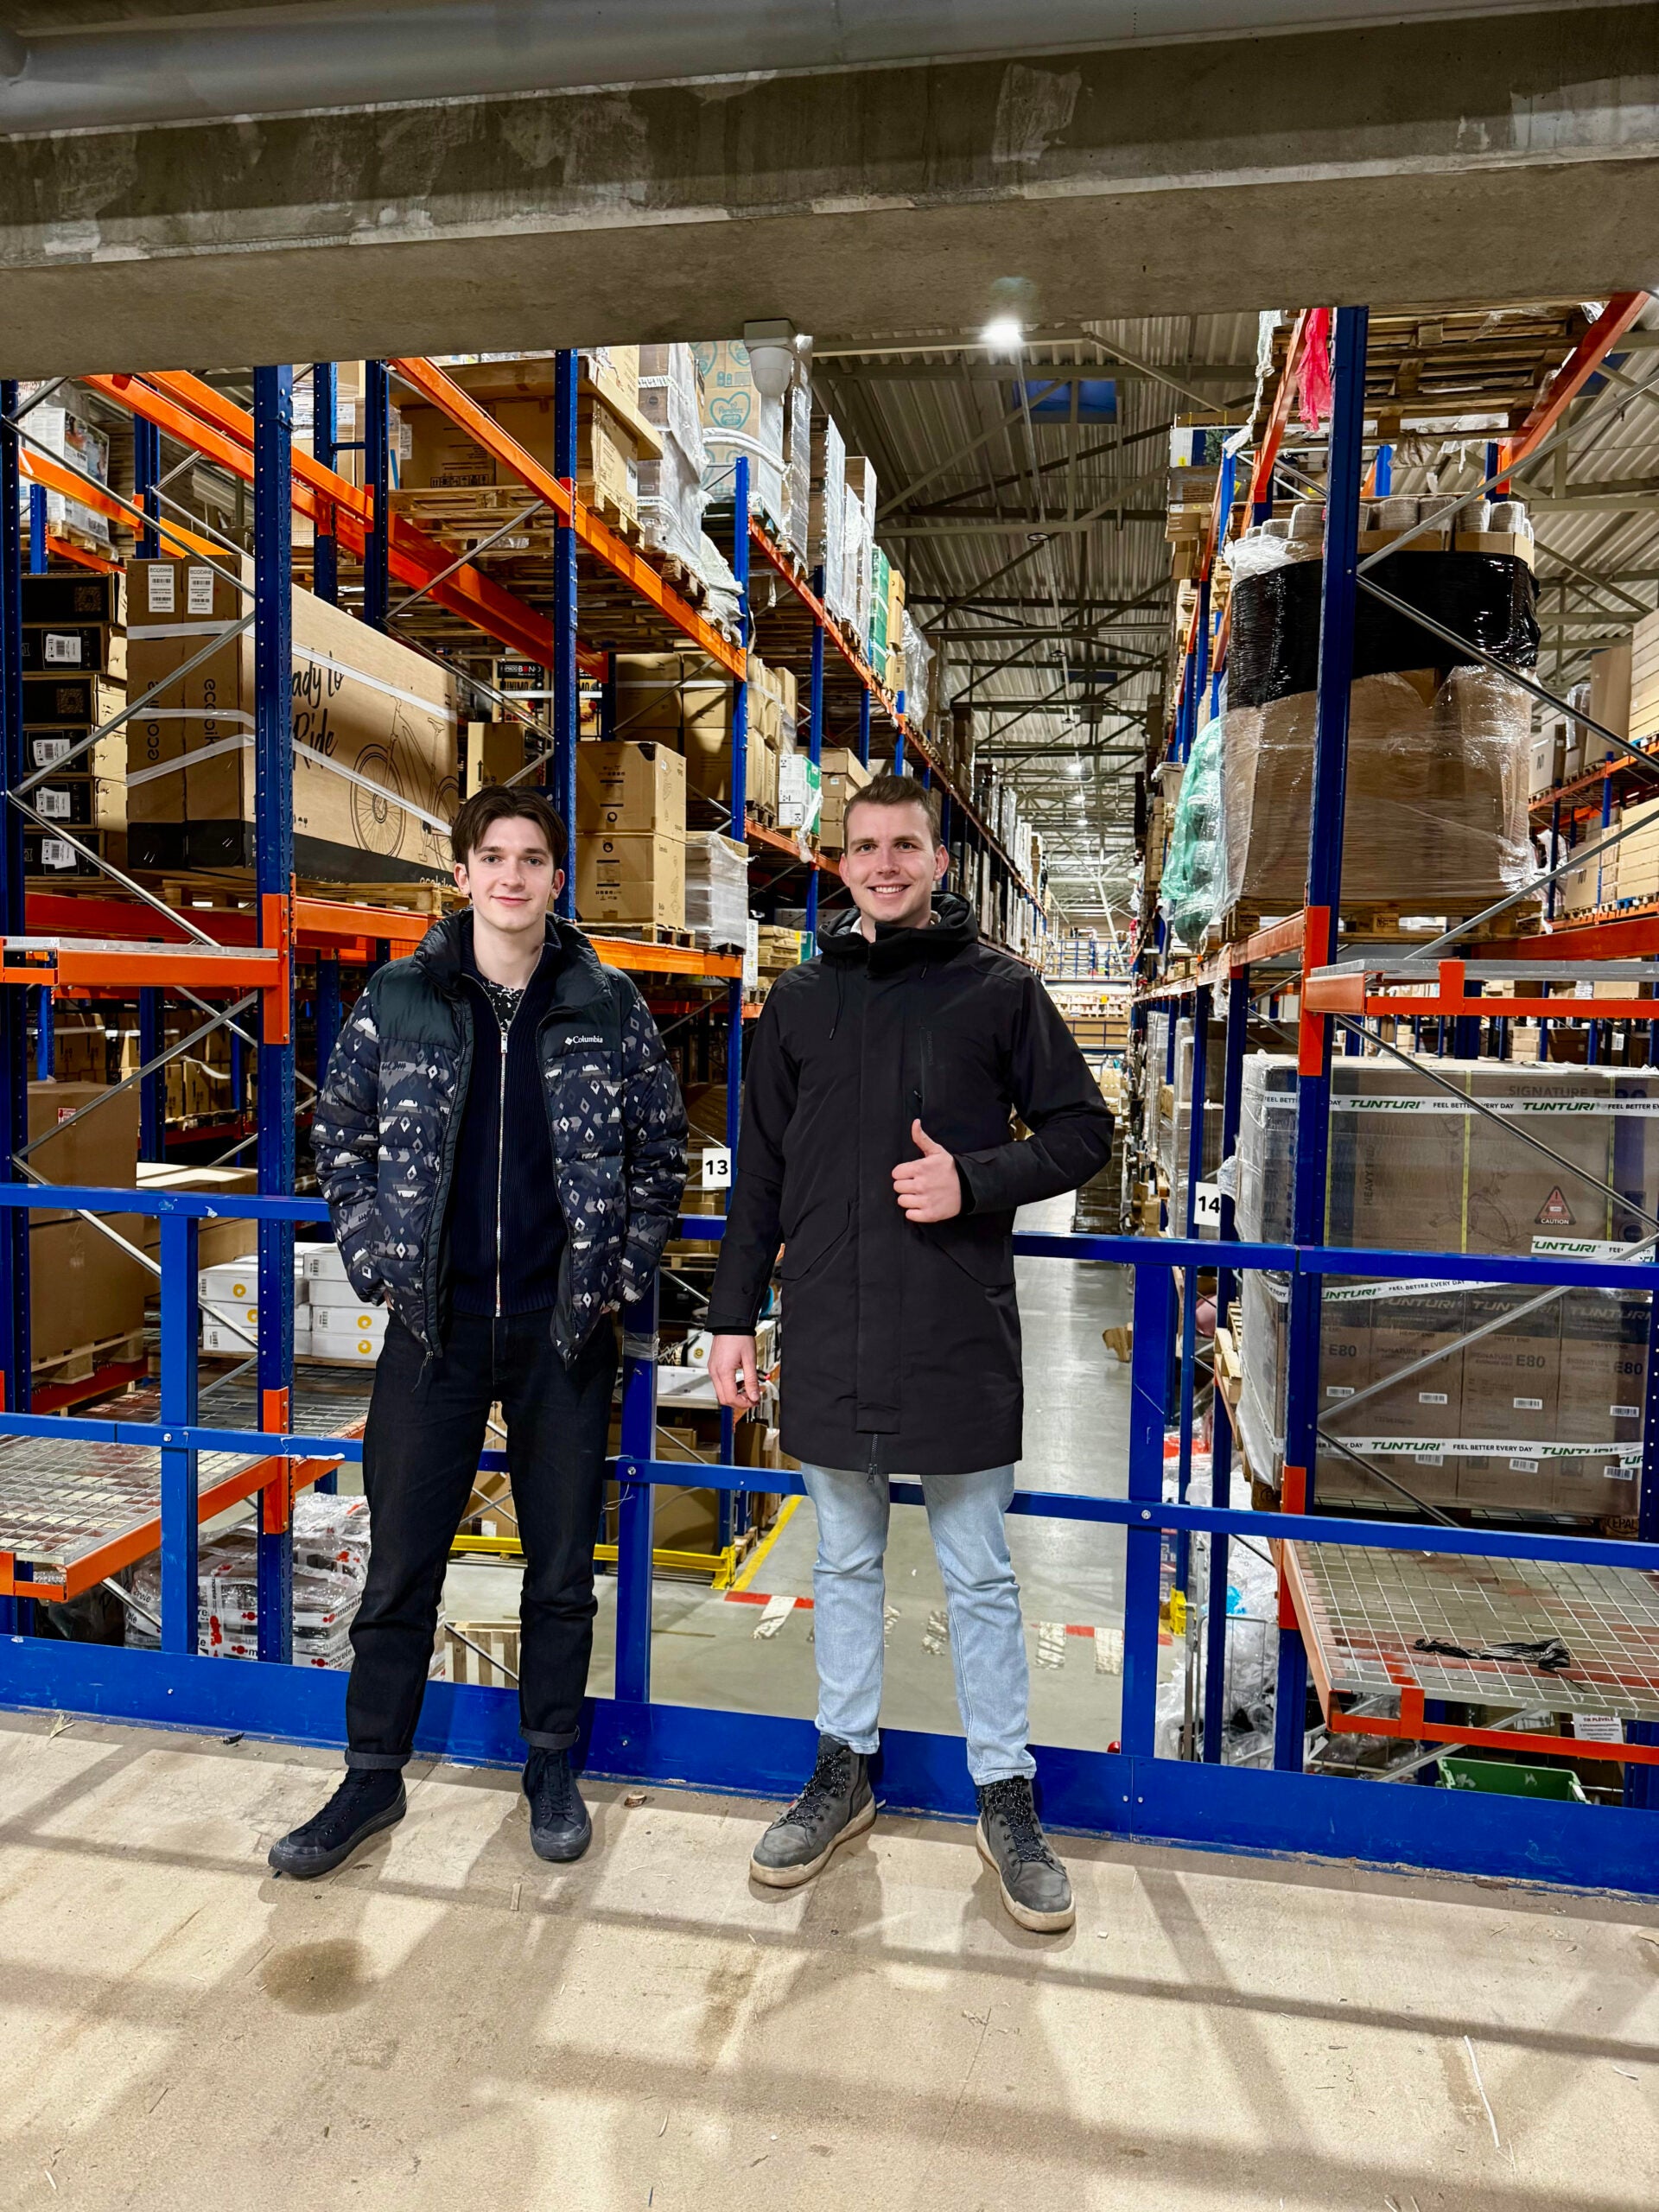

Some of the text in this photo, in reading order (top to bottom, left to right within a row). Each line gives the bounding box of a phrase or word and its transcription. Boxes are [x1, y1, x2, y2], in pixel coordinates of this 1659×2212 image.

[1508, 1085, 1588, 1098] SIGNATURE
[1349, 1099, 1421, 1109] TUNTURI
[1522, 1103, 1596, 1111] TUNTURI
[705, 1159, 728, 1175] 13
[1363, 1170, 1375, 1206] HEAVY
[1198, 1195, 1220, 1214] 14
[1321, 1288, 1376, 1300] UNTURI
[1329, 1344, 1357, 1357] E80
[1516, 1354, 1546, 1368] E80
[1613, 1361, 1643, 1375] E80
[1371, 1441, 1441, 1452] TUNTURI
[337, 1595, 362, 1618] morele
[328, 1648, 353, 1667] morele
